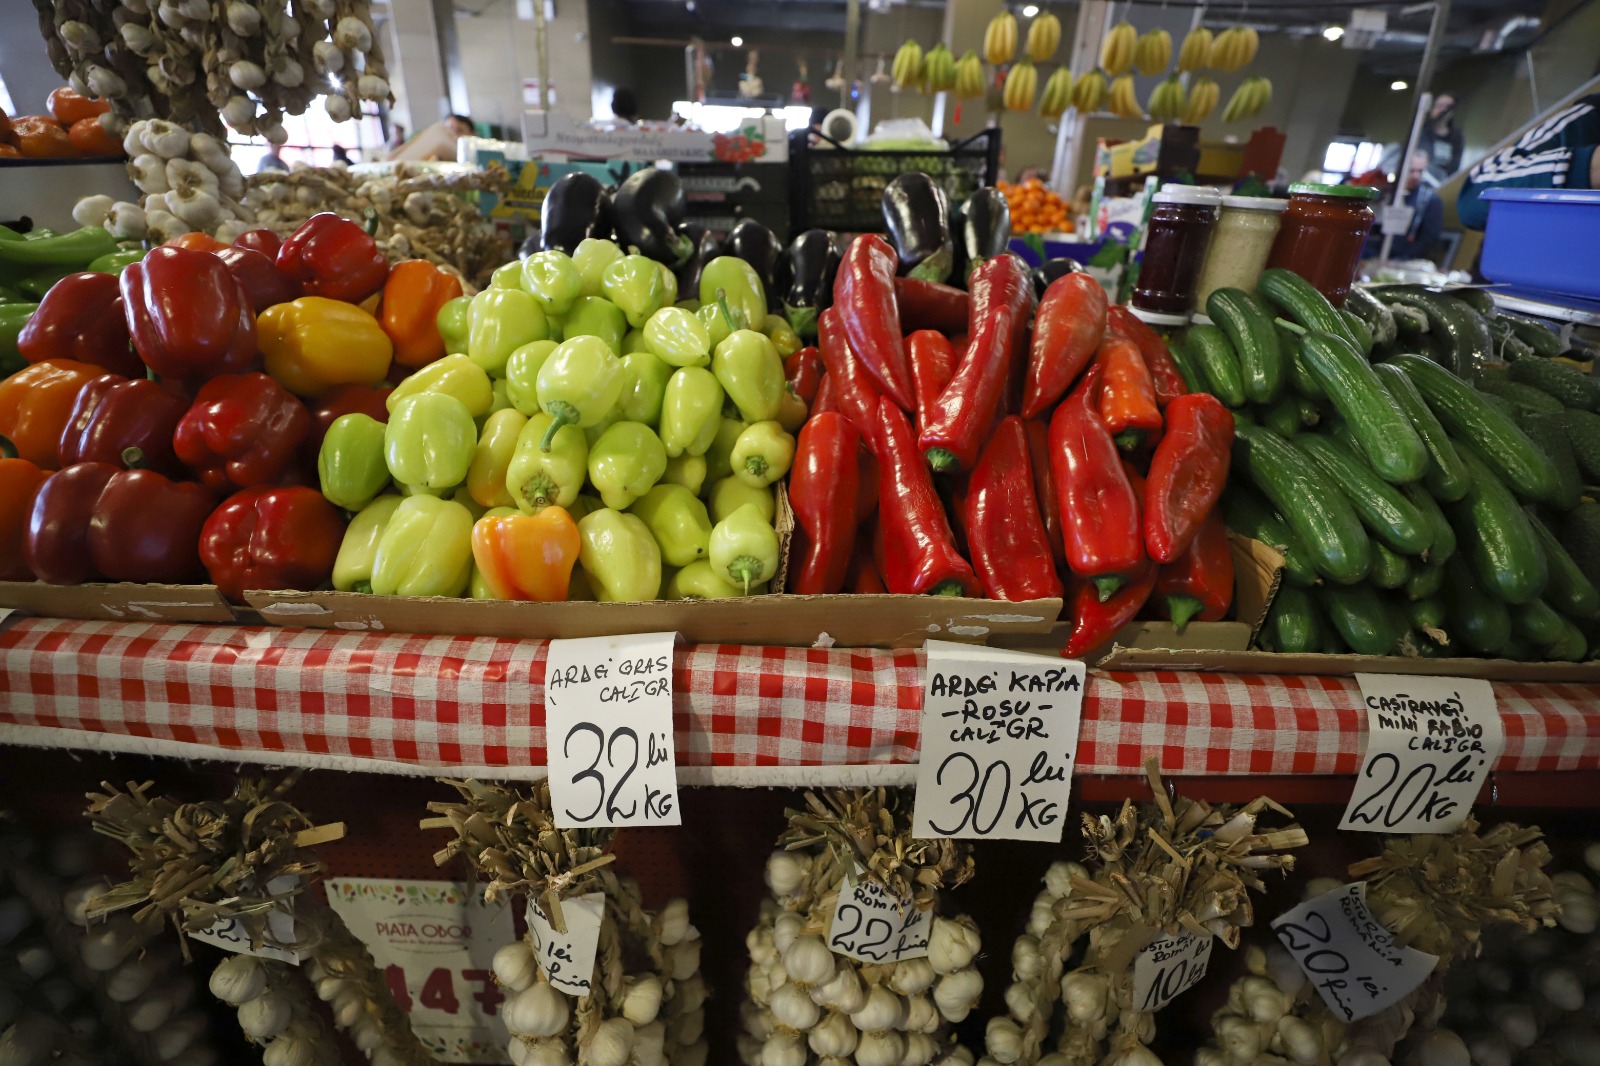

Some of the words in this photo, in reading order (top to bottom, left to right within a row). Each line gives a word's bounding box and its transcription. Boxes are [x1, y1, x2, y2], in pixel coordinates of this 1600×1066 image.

[619, 656, 669, 676] GRAS
[564, 722, 639, 823] 32
[929, 752, 1010, 835] 30
[1020, 751, 1070, 786] lei
[1349, 753, 1437, 827] 20
[1434, 754, 1484, 786] lei
[645, 784, 673, 819] KG
[1015, 792, 1058, 830] KG
[1417, 791, 1457, 822] KG
[548, 941, 572, 963] lei
[832, 904, 892, 961] 22
[1274, 911, 1349, 973] 20
[1140, 959, 1187, 1011] 10
[1356, 976, 1388, 999] lei
